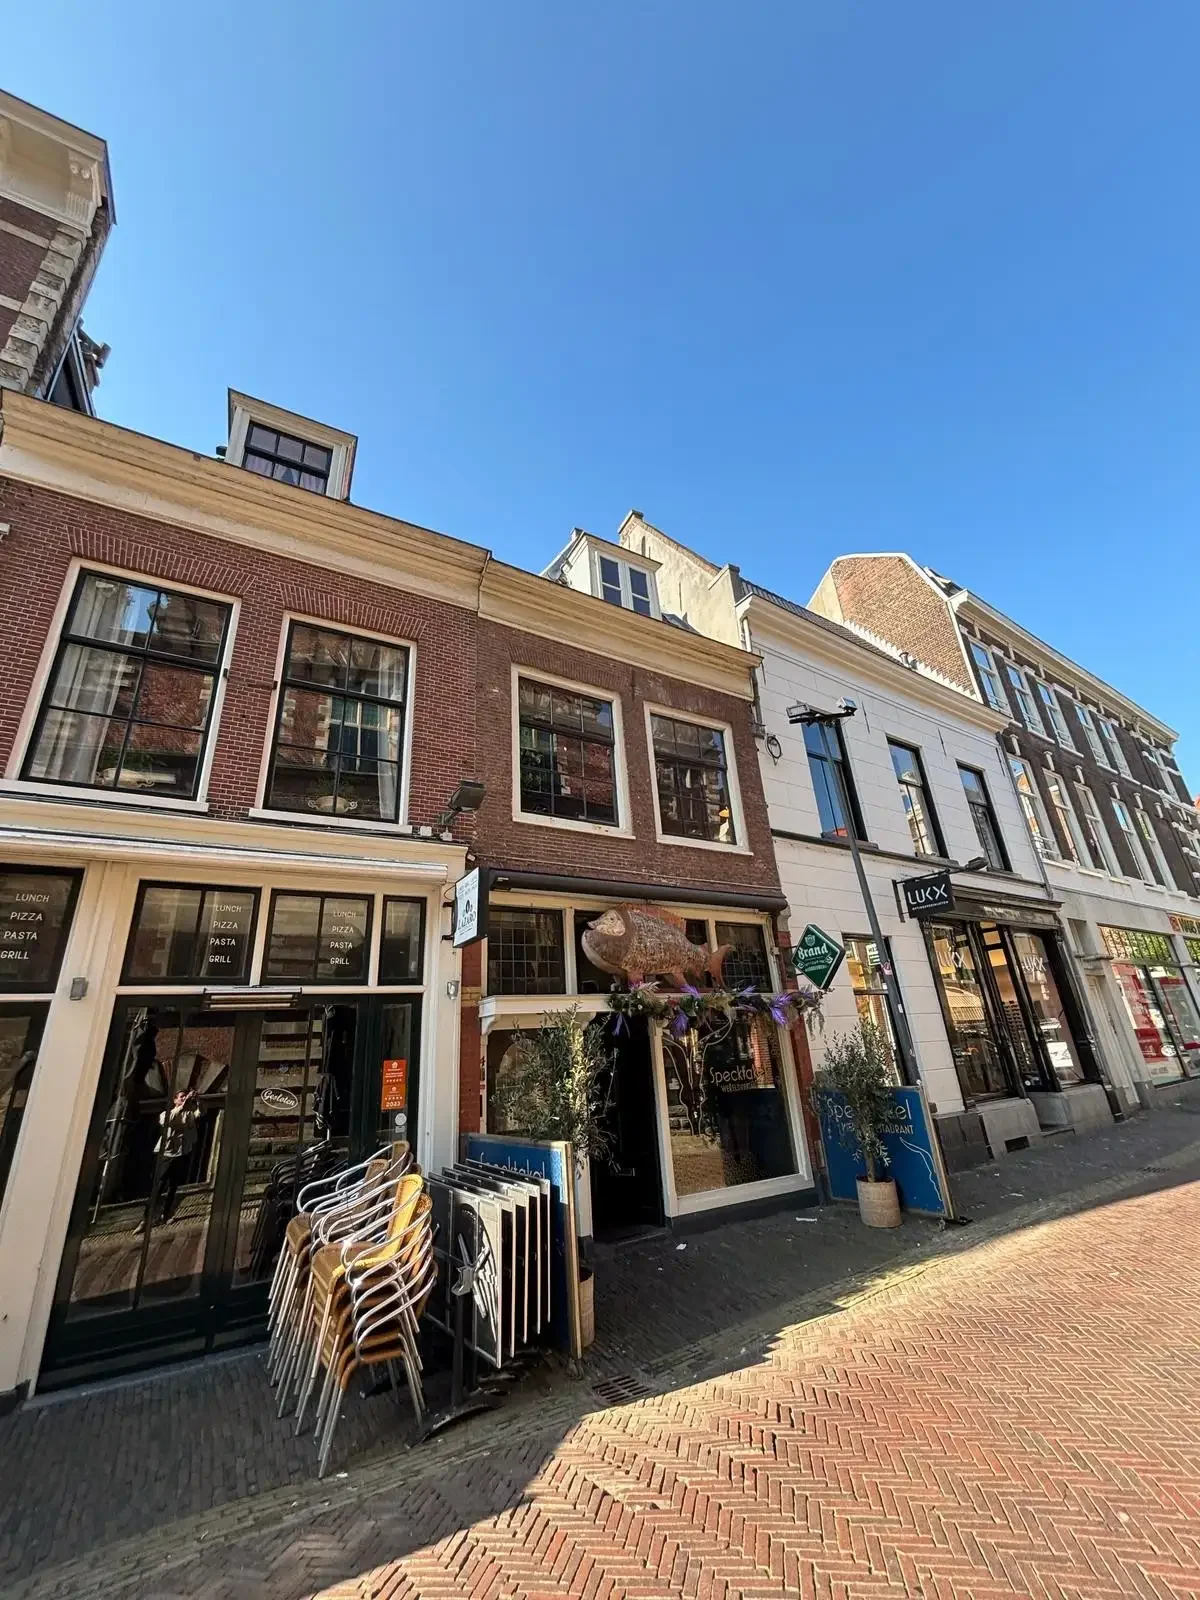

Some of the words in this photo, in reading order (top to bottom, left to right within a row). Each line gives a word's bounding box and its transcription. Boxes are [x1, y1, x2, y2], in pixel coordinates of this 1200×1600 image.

[16, 893, 50, 902] LUNCH
[908, 884, 948, 904] LUKX
[215, 904, 242, 912] LUNCH
[10, 912, 43, 921] PIZZA
[212, 920, 238, 929] PIZZA
[332, 926, 354, 934] PIZZA
[4, 931, 38, 940] PASTA
[210, 938, 236, 946] PASTA
[0, 950, 30, 960] GRILL
[798, 942, 828, 960] Brand
[208, 955, 232, 964] GRILL
[263, 1090, 295, 1107] Gesloten
[826, 1098, 912, 1122] Speel
